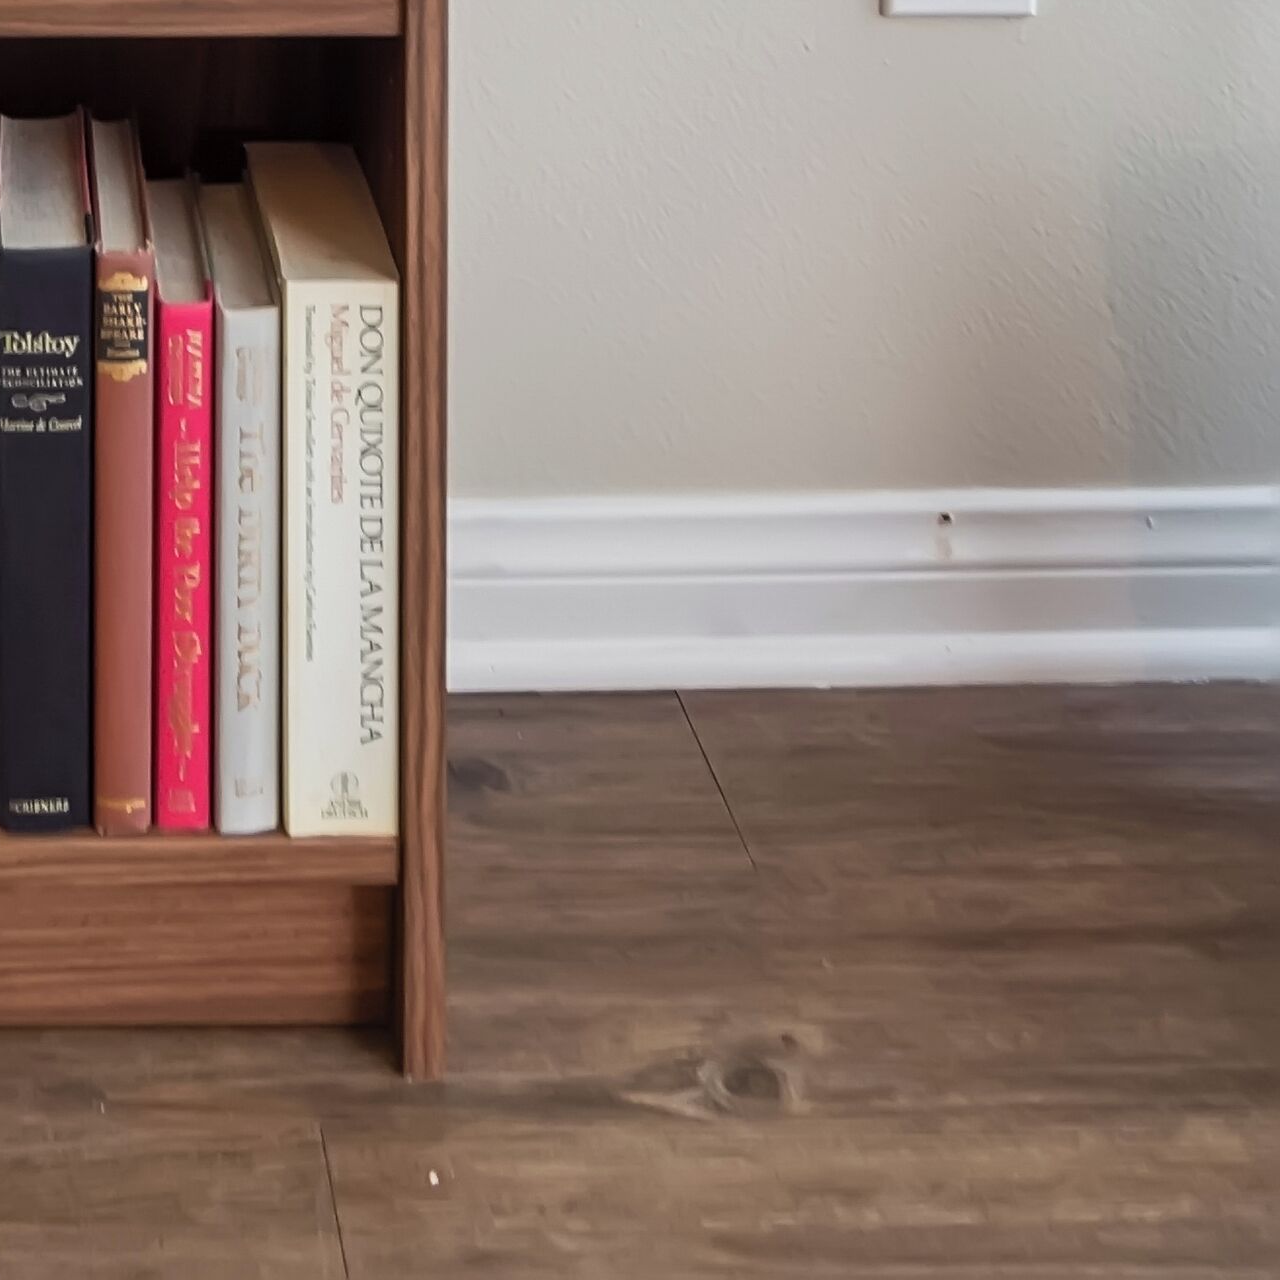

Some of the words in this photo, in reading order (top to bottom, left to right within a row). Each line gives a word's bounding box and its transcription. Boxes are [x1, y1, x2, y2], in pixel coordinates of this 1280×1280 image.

[323, 303, 352, 378] Miguel
[359, 303, 384, 378] DON
[329, 380, 352, 405] de
[328, 406, 351, 505] Cervantes
[354, 381, 385, 510] QUIXOTE
[359, 515, 384, 555] DE
[359, 559, 384, 598] LA
[359, 602, 384, 746] MANCHA
